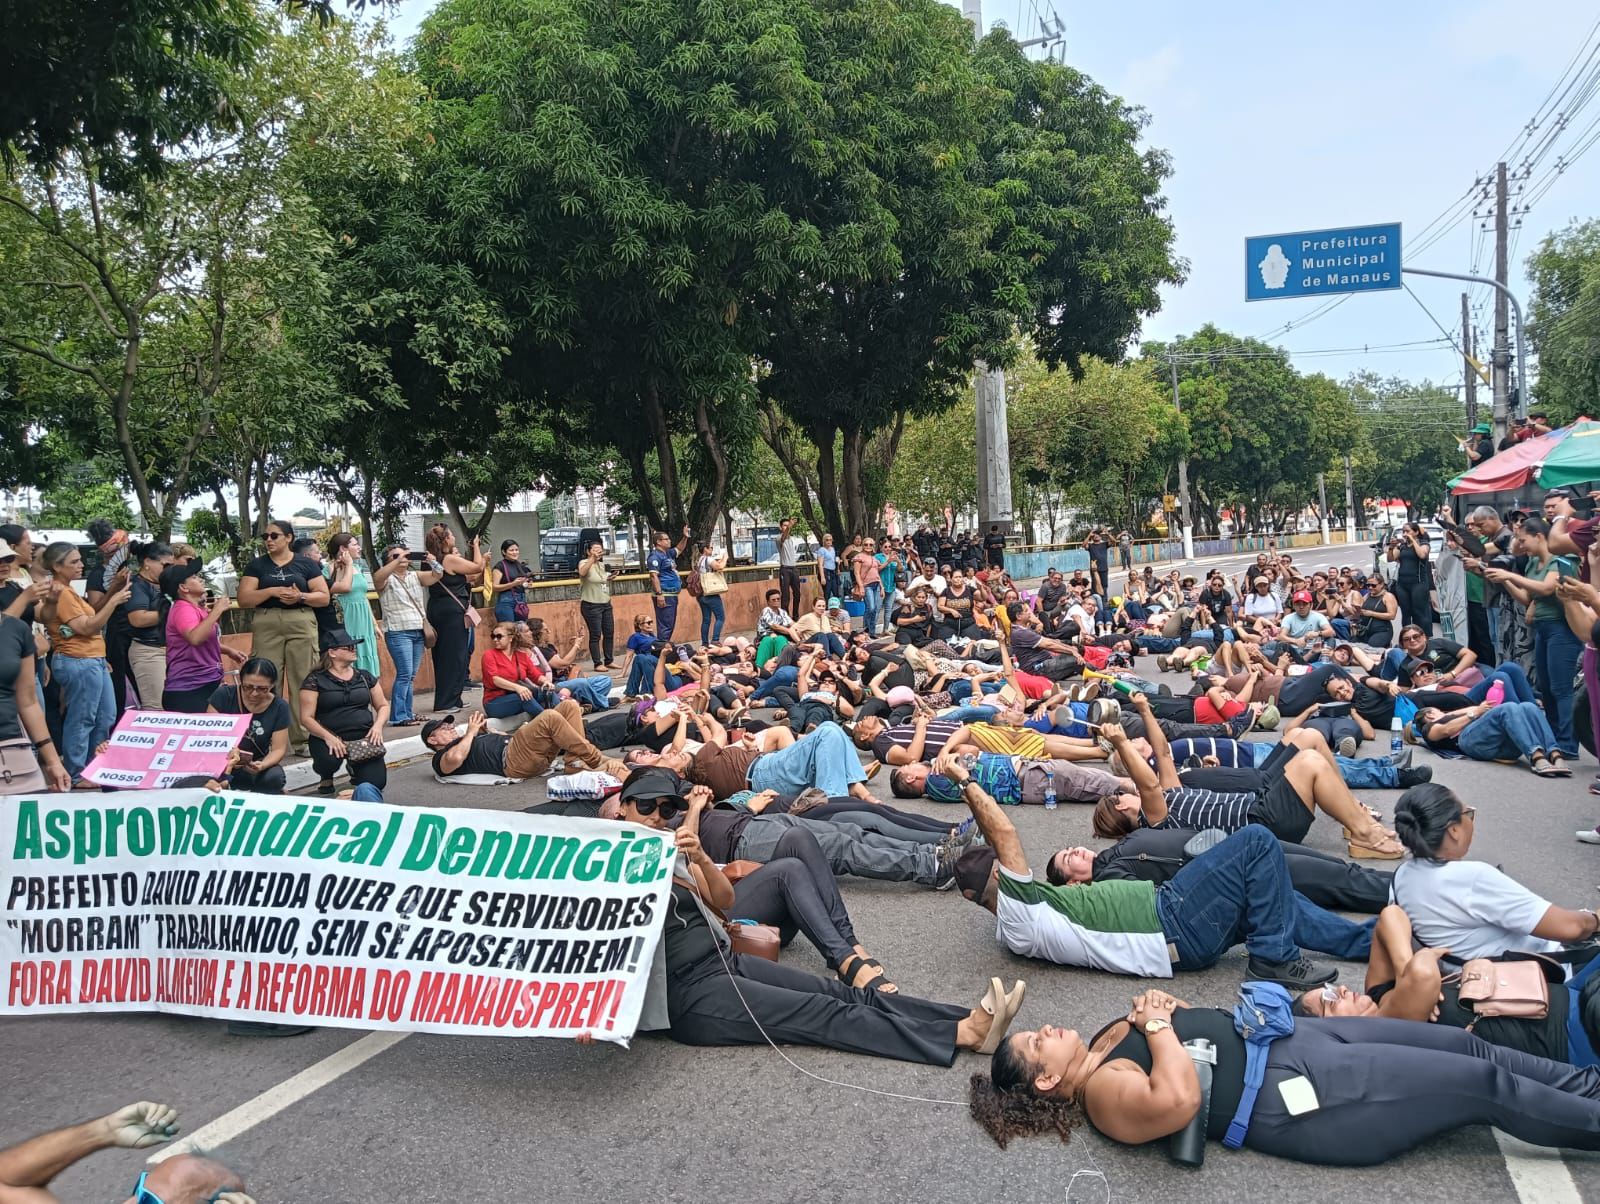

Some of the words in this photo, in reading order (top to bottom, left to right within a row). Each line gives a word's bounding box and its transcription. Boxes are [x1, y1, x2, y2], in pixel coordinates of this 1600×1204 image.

[1302, 235, 1387, 252] Prefeitura
[1302, 252, 1384, 269] Municipal
[1302, 276, 1321, 287] de
[1327, 271, 1391, 285] Manaus
[134, 716, 233, 728] APOSENTADORIA
[116, 734, 155, 745] DIGNA
[189, 740, 228, 748] JUSTA
[99, 772, 143, 783] NOSSO
[7, 873, 138, 911] PREFEITO
[141, 870, 200, 906] DAVID
[200, 870, 312, 911] ALMEIDA
[314, 873, 396, 914] QUER
[396, 884, 463, 921] QUE
[462, 890, 657, 931] SERVIDORES
[155, 914, 300, 959] TRABALHANDO,
[306, 918, 370, 957] SEM
[369, 921, 410, 960] SE
[406, 928, 646, 974] APOSENTAREM!
[8, 960, 72, 1007] FORA
[79, 958, 151, 1002] DAVID
[155, 957, 219, 1007] ALMEIDA
[219, 962, 233, 1008] E
[236, 961, 252, 1008] A
[254, 961, 368, 1020] REFORMA
[368, 968, 411, 1023] DO
[410, 971, 626, 1031] MANAUSPREV!
